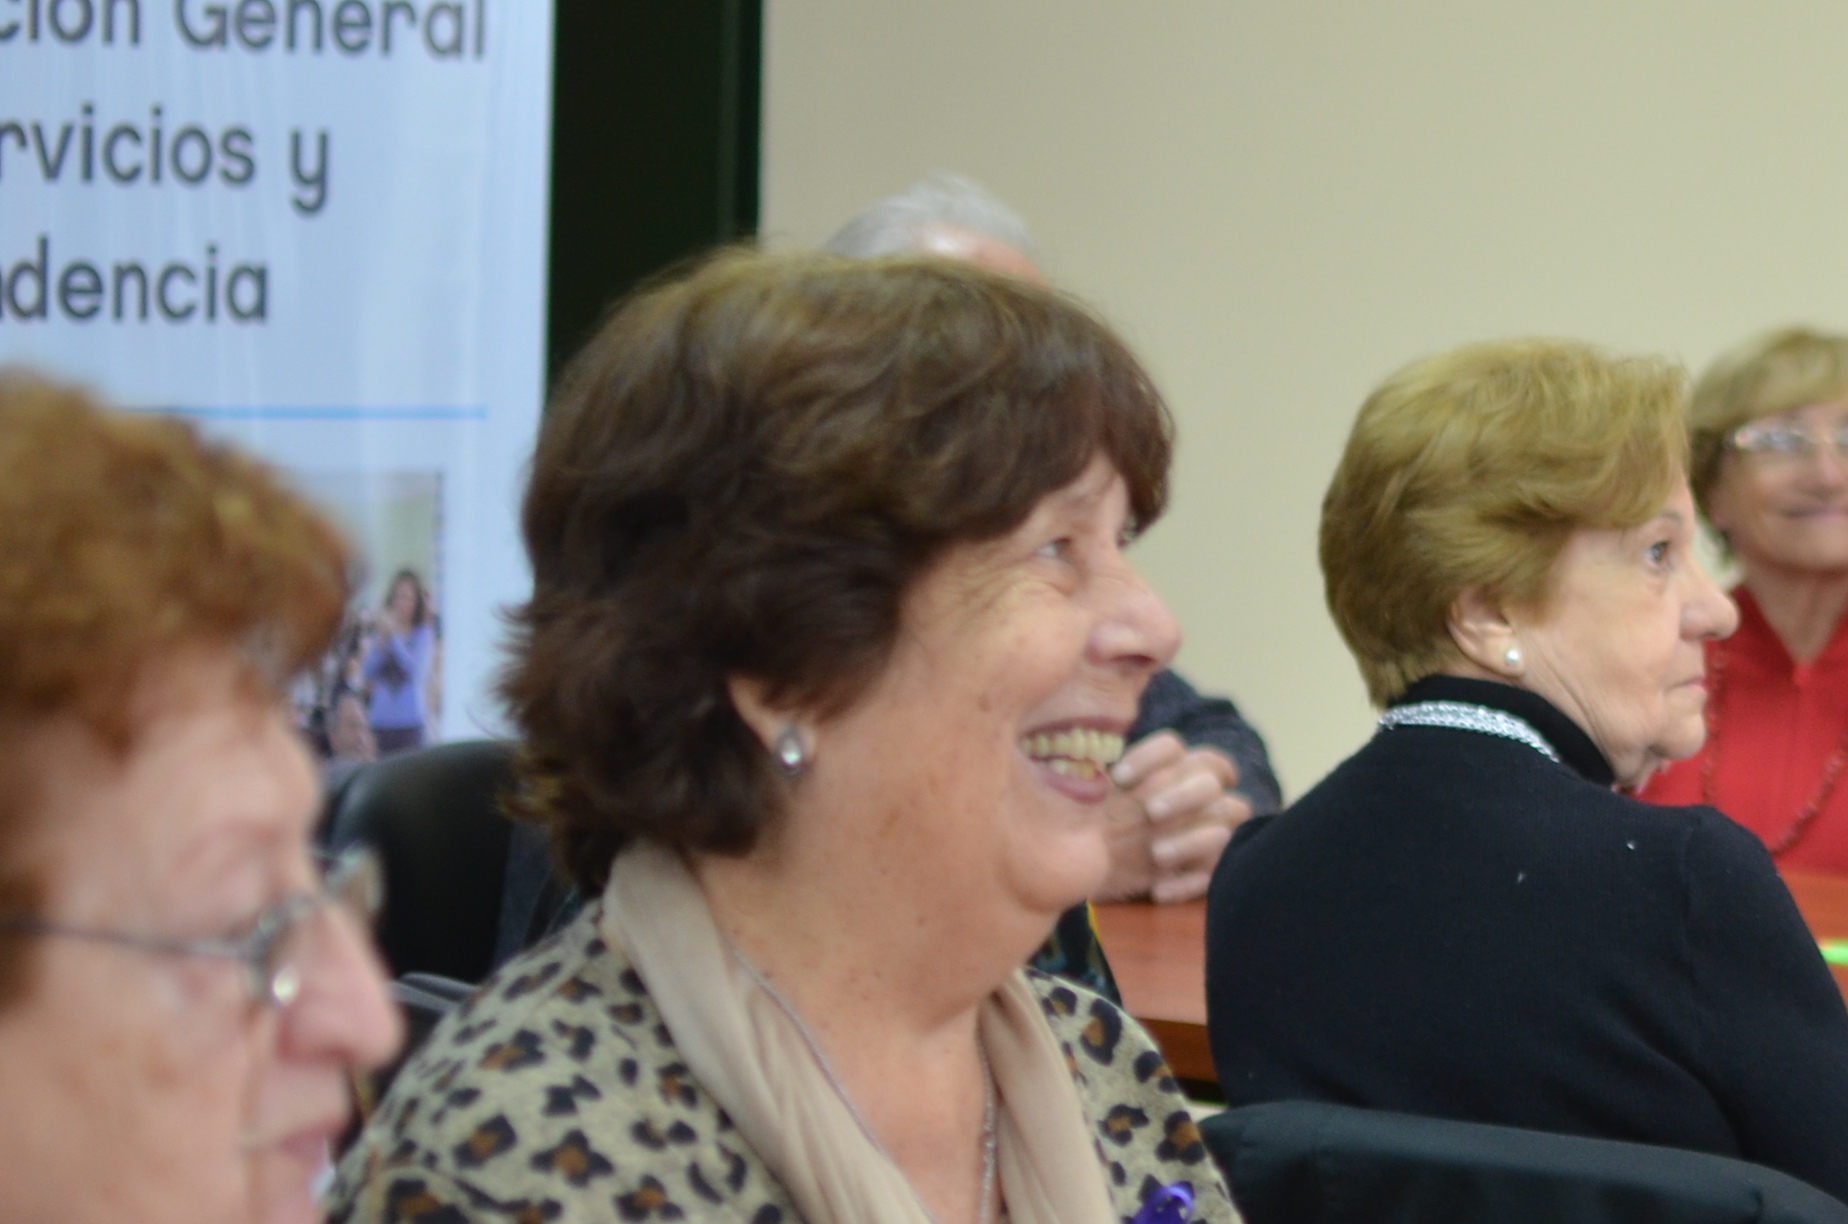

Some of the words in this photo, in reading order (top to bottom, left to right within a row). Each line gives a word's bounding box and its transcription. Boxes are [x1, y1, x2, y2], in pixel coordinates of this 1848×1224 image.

[174, 0, 485, 60] General
[289, 127, 330, 216] y
[0, 233, 270, 325] dencia
